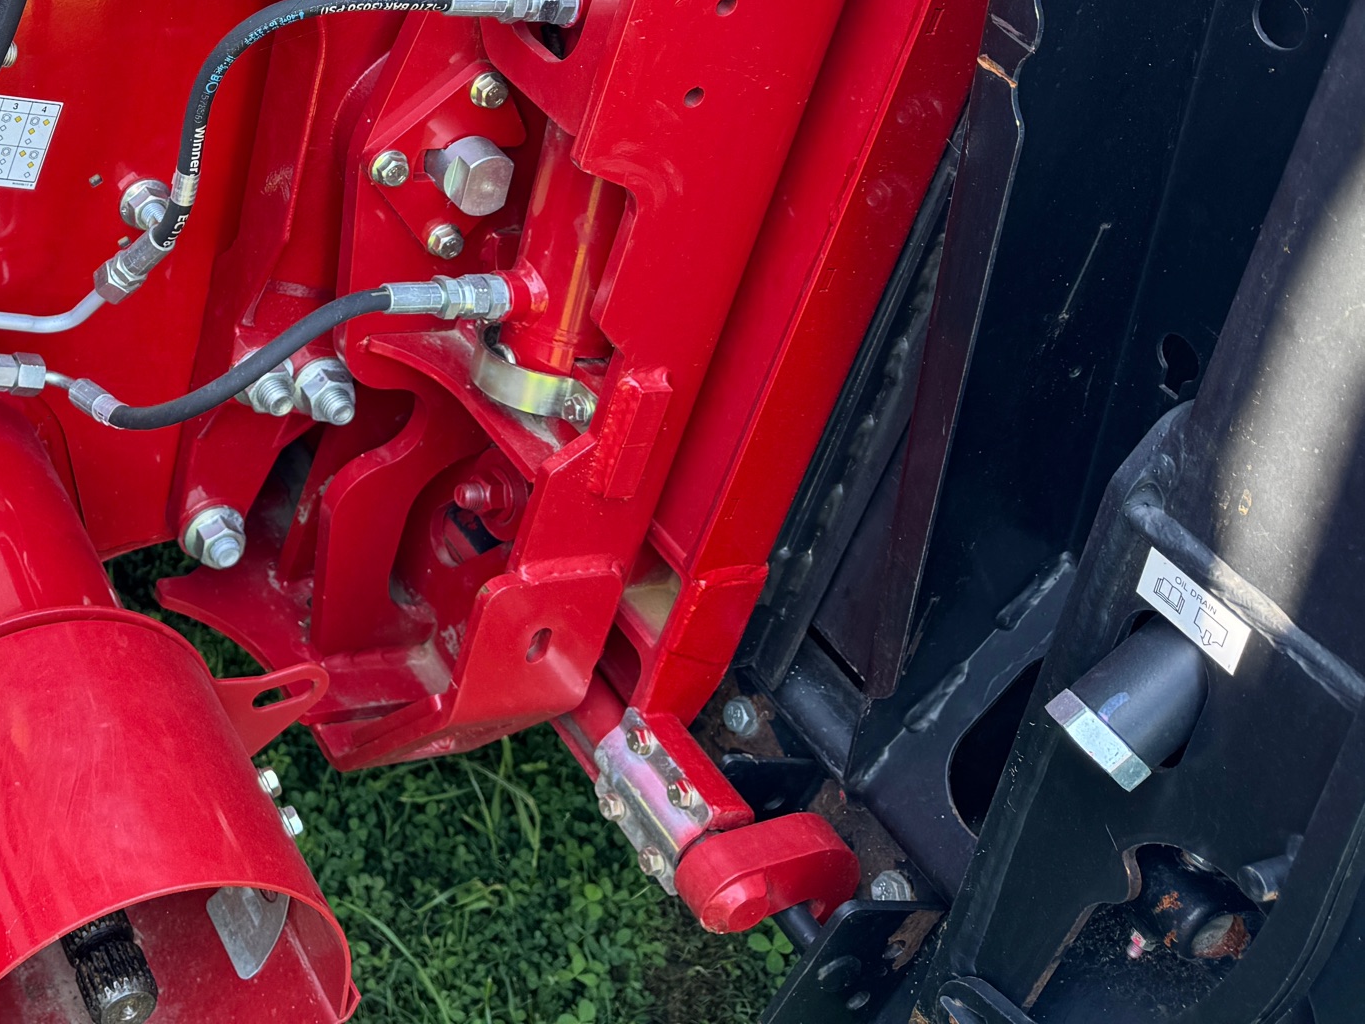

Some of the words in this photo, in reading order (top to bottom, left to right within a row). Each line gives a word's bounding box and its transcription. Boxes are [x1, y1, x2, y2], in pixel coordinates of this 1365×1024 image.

[385, 2, 409, 10] BAR
[12, 102, 19, 110] 3
[40, 105, 48, 113] 4
[189, 124, 207, 173] Winner
[1174, 576, 1188, 592] OIL
[1190, 589, 1217, 615] DRAIN
